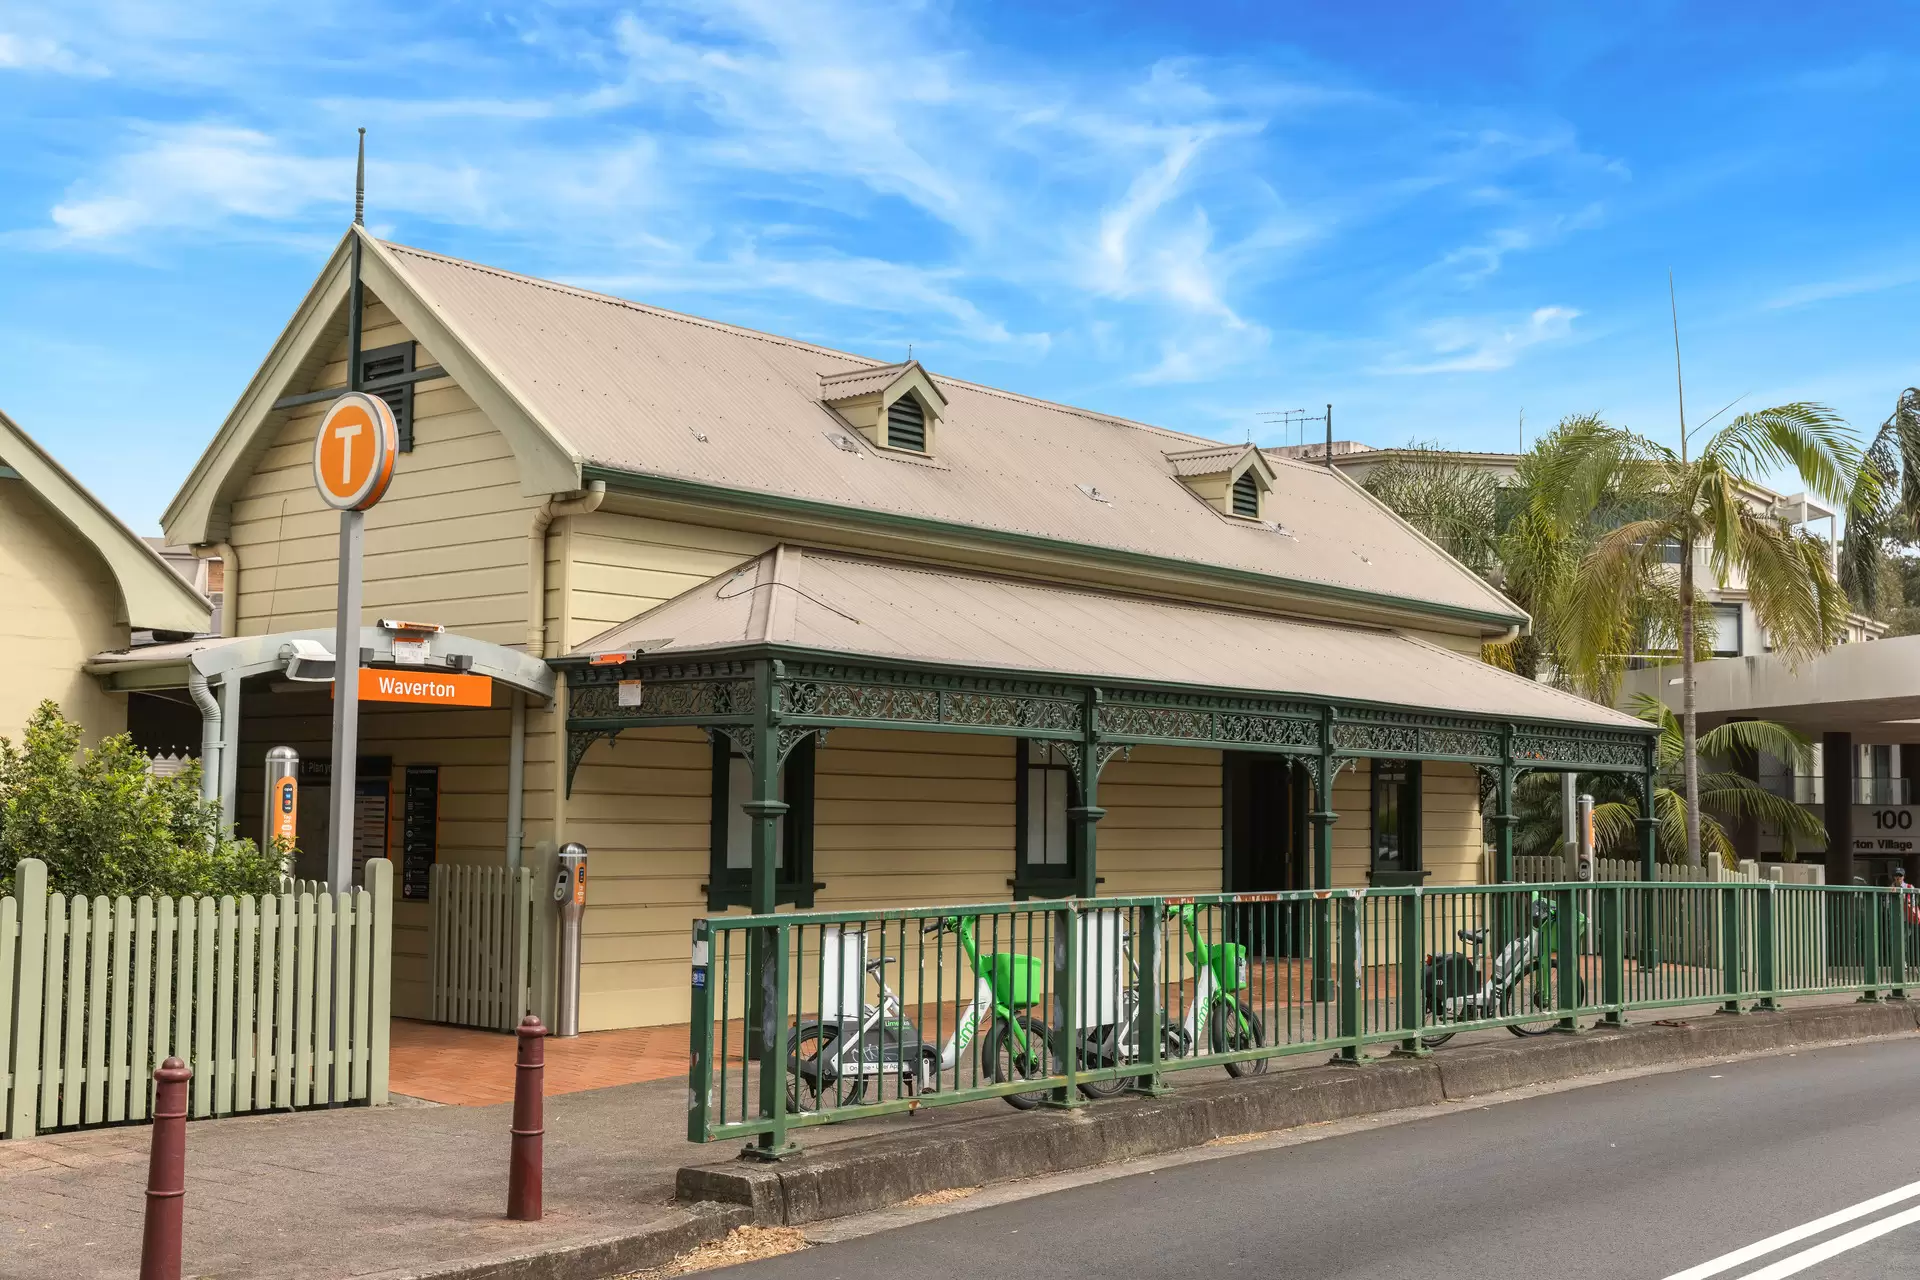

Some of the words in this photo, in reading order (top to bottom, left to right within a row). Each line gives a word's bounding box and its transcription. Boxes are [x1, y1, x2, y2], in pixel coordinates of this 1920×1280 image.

[335, 424, 362, 485] T
[378, 676, 455, 698] Waverton
[1872, 810, 1913, 830] 100
[1877, 839, 1913, 852] Village
